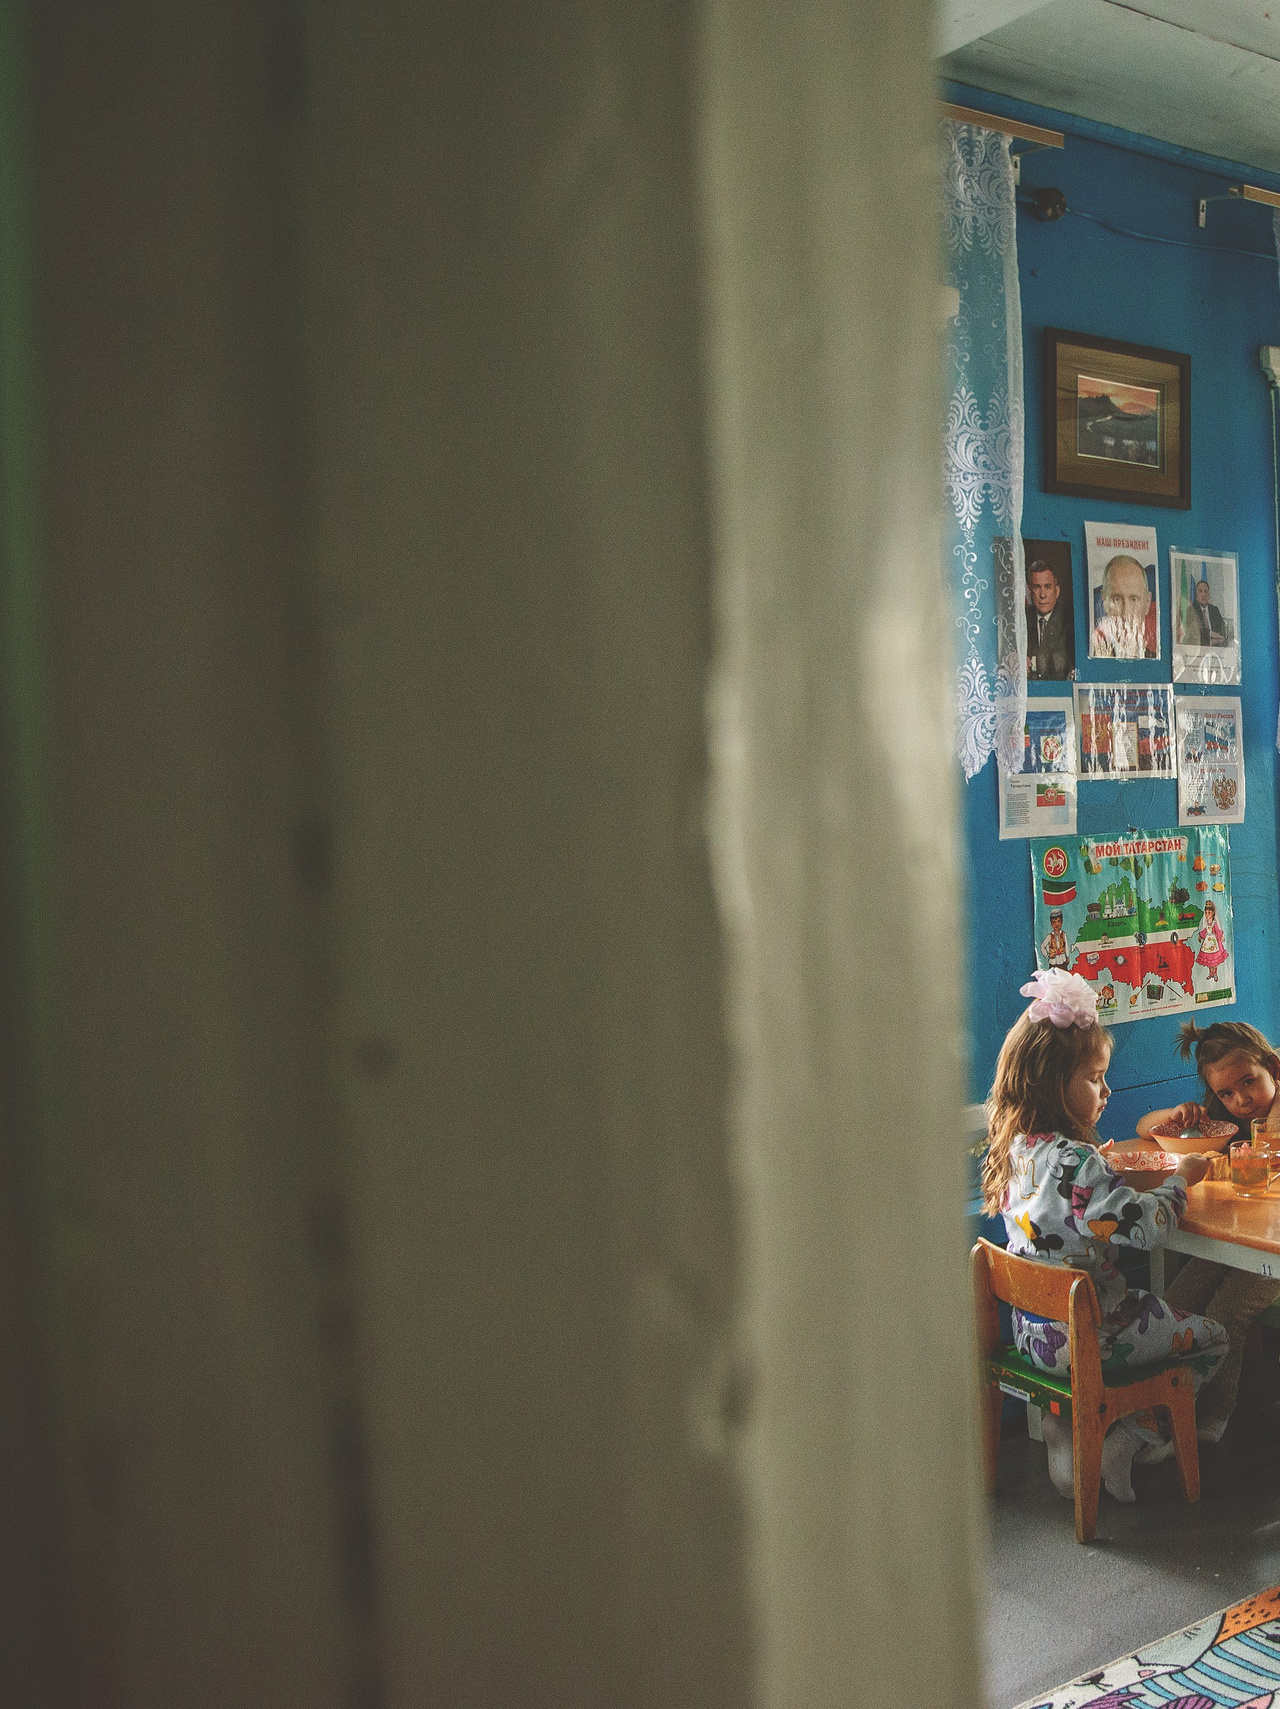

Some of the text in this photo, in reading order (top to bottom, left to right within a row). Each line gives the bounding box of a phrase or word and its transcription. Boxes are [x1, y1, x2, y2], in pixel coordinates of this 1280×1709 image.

[1096, 537, 1149, 550] НАШ ПРЕЗИДЕНТ
[1095, 839, 1181, 858] МОЙ ТАТАРСТАН
[1262, 1264, 1272, 1276] 11
